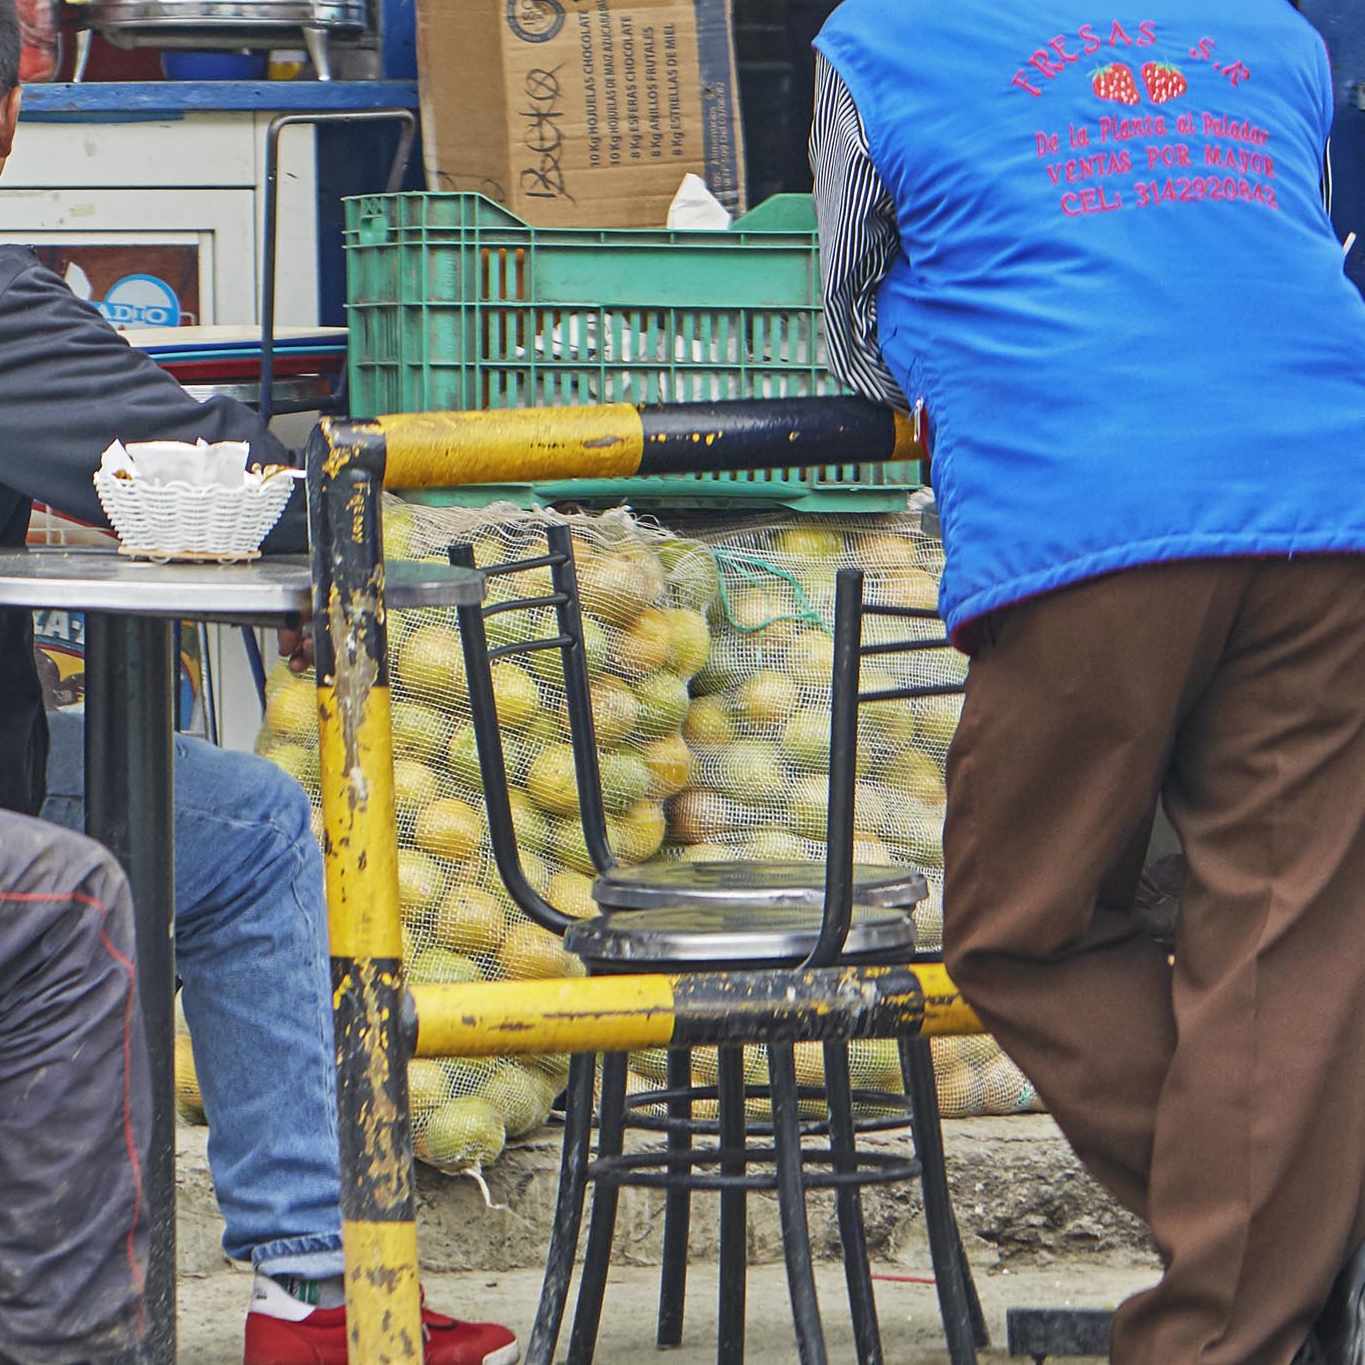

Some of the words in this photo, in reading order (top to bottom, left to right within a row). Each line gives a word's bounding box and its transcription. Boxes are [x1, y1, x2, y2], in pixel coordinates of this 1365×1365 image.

[582, 8, 594, 74] CHOCOLATE
[623, 15, 636, 84] CHOCOLATE
[664, 22, 677, 50] MIEL
[643, 26, 658, 82] FRUTALES
[666, 51, 677, 69] DE
[1011, 19, 1157, 97] FRESAS
[604, 75, 616, 88] DE
[585, 75, 598, 135] HOJUELAS
[604, 89, 619, 135] HOJUELAS
[627, 86, 641, 132] ESFERAS
[646, 85, 660, 132] ANILLOS
[667, 71, 681, 131] ESTRELLAS
[588, 136, 602, 151] Kg
[609, 136, 622, 150] Kg
[630, 133, 643, 147] Kg
[650, 132, 664, 147] Kg
[671, 131, 685, 146] Kg
[1035, 131, 1060, 157] De
[1069, 122, 1089, 149] la
[1100, 114, 1167, 143] Planta
[1176, 110, 1195, 135] al
[1201, 110, 1270, 146] Paladar
[590, 152, 601, 166] 10
[609, 151, 621, 166] 10
[631, 148, 641, 158] 8
[651, 148, 662, 157] 8
[672, 147, 683, 156] 8
[1046, 149, 1133, 186] VENTAS
[1146, 144, 1192, 170] POR
[1204, 144, 1277, 179] MAYOR
[1133, 176, 1280, 210] 3142920842
